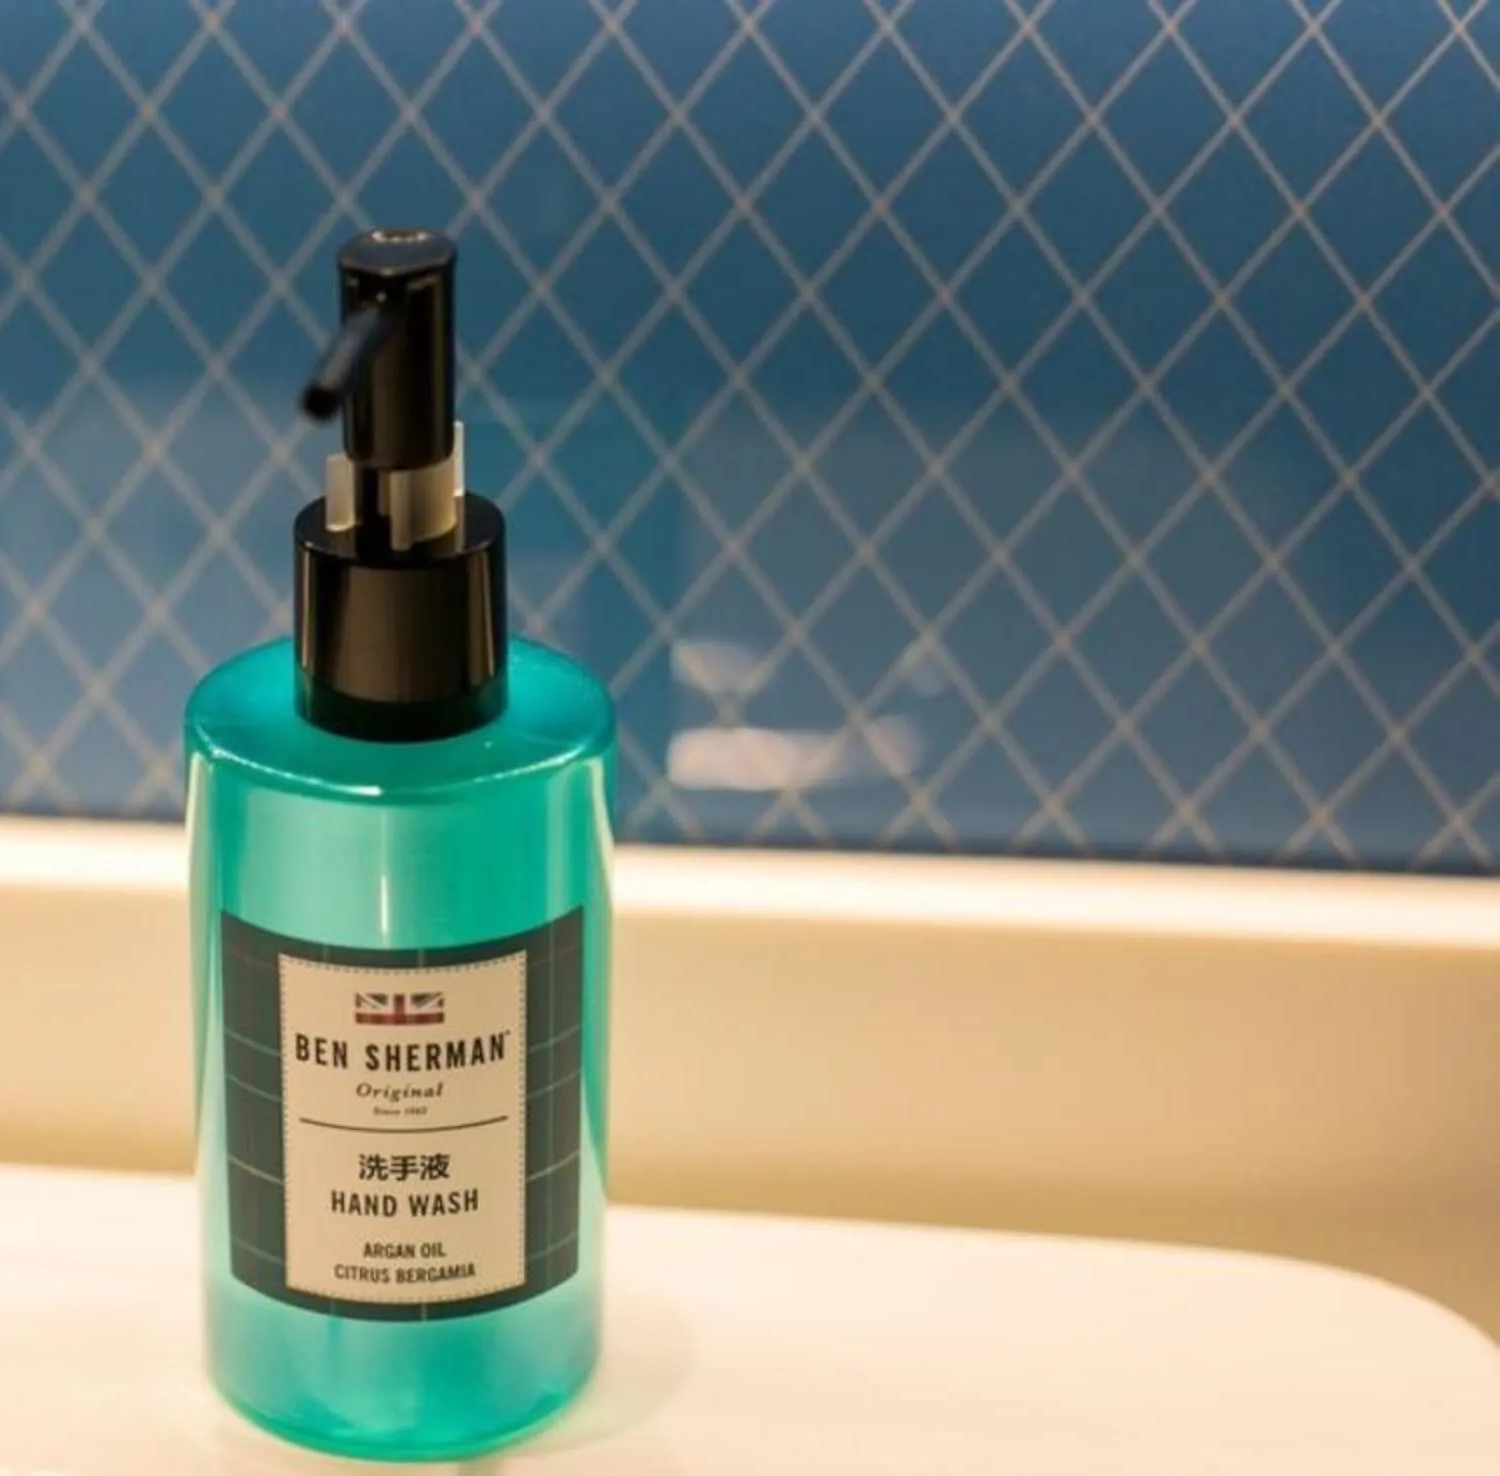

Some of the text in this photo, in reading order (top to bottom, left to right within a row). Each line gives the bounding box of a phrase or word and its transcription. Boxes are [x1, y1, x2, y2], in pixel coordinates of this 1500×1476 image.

[295, 1032, 505, 1072] BEN SHERMAN
[356, 1082, 444, 1102] Original
[358, 1152, 451, 1181] 洗手液
[331, 1188, 478, 1217] HAND WASH
[363, 1242, 447, 1258] ARGAN OIL
[334, 1263, 476, 1284] CITRUS BERGAMIA
